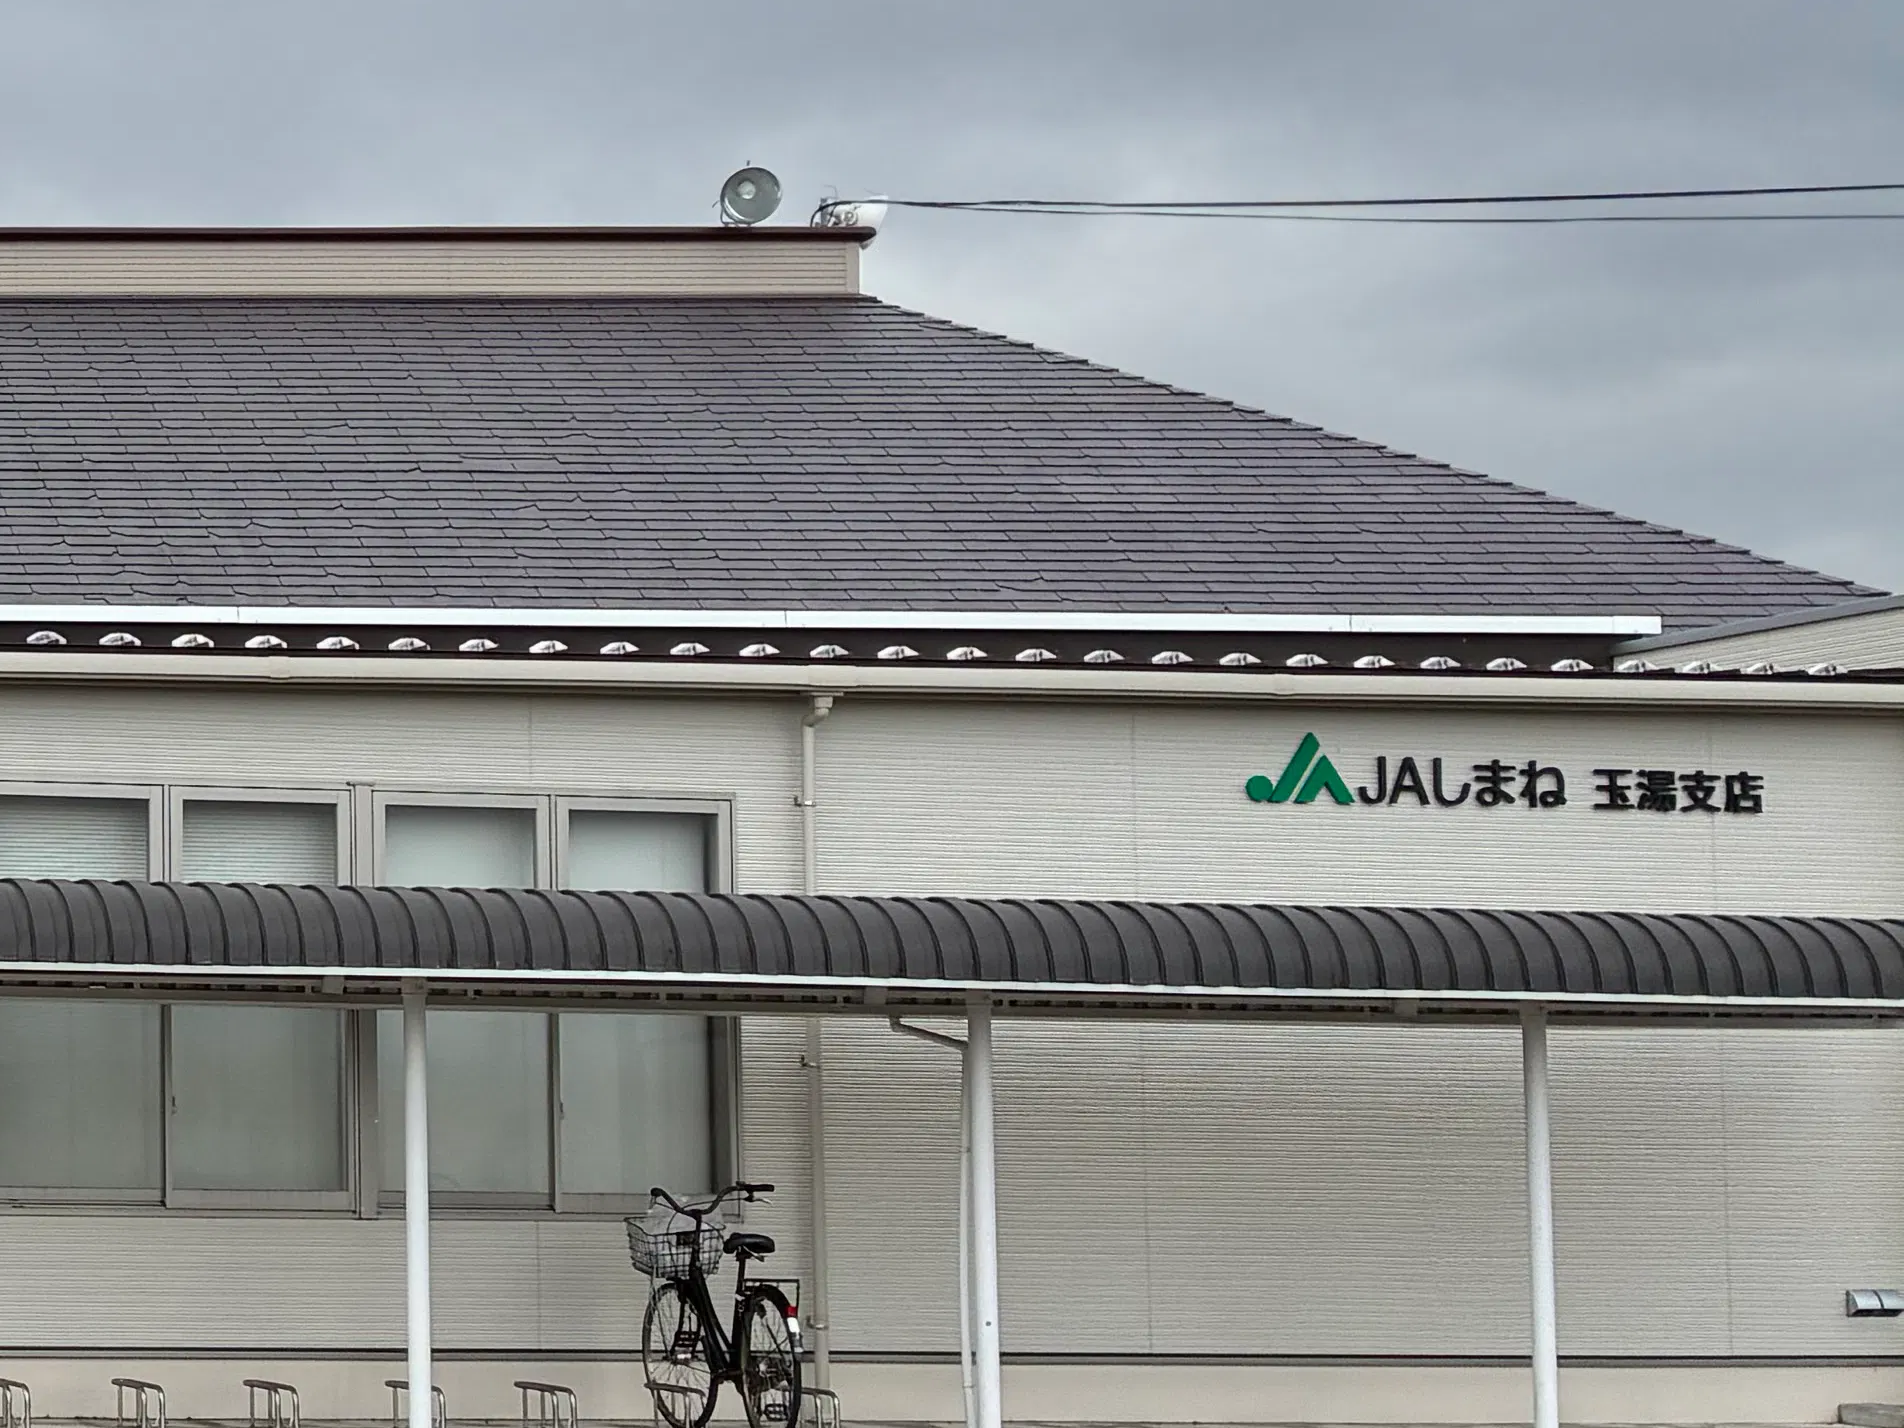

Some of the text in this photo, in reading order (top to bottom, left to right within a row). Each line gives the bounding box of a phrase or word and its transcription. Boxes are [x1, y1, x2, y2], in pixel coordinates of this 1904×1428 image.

[1358, 755, 1765, 814] JAしまね 玉湯支店
